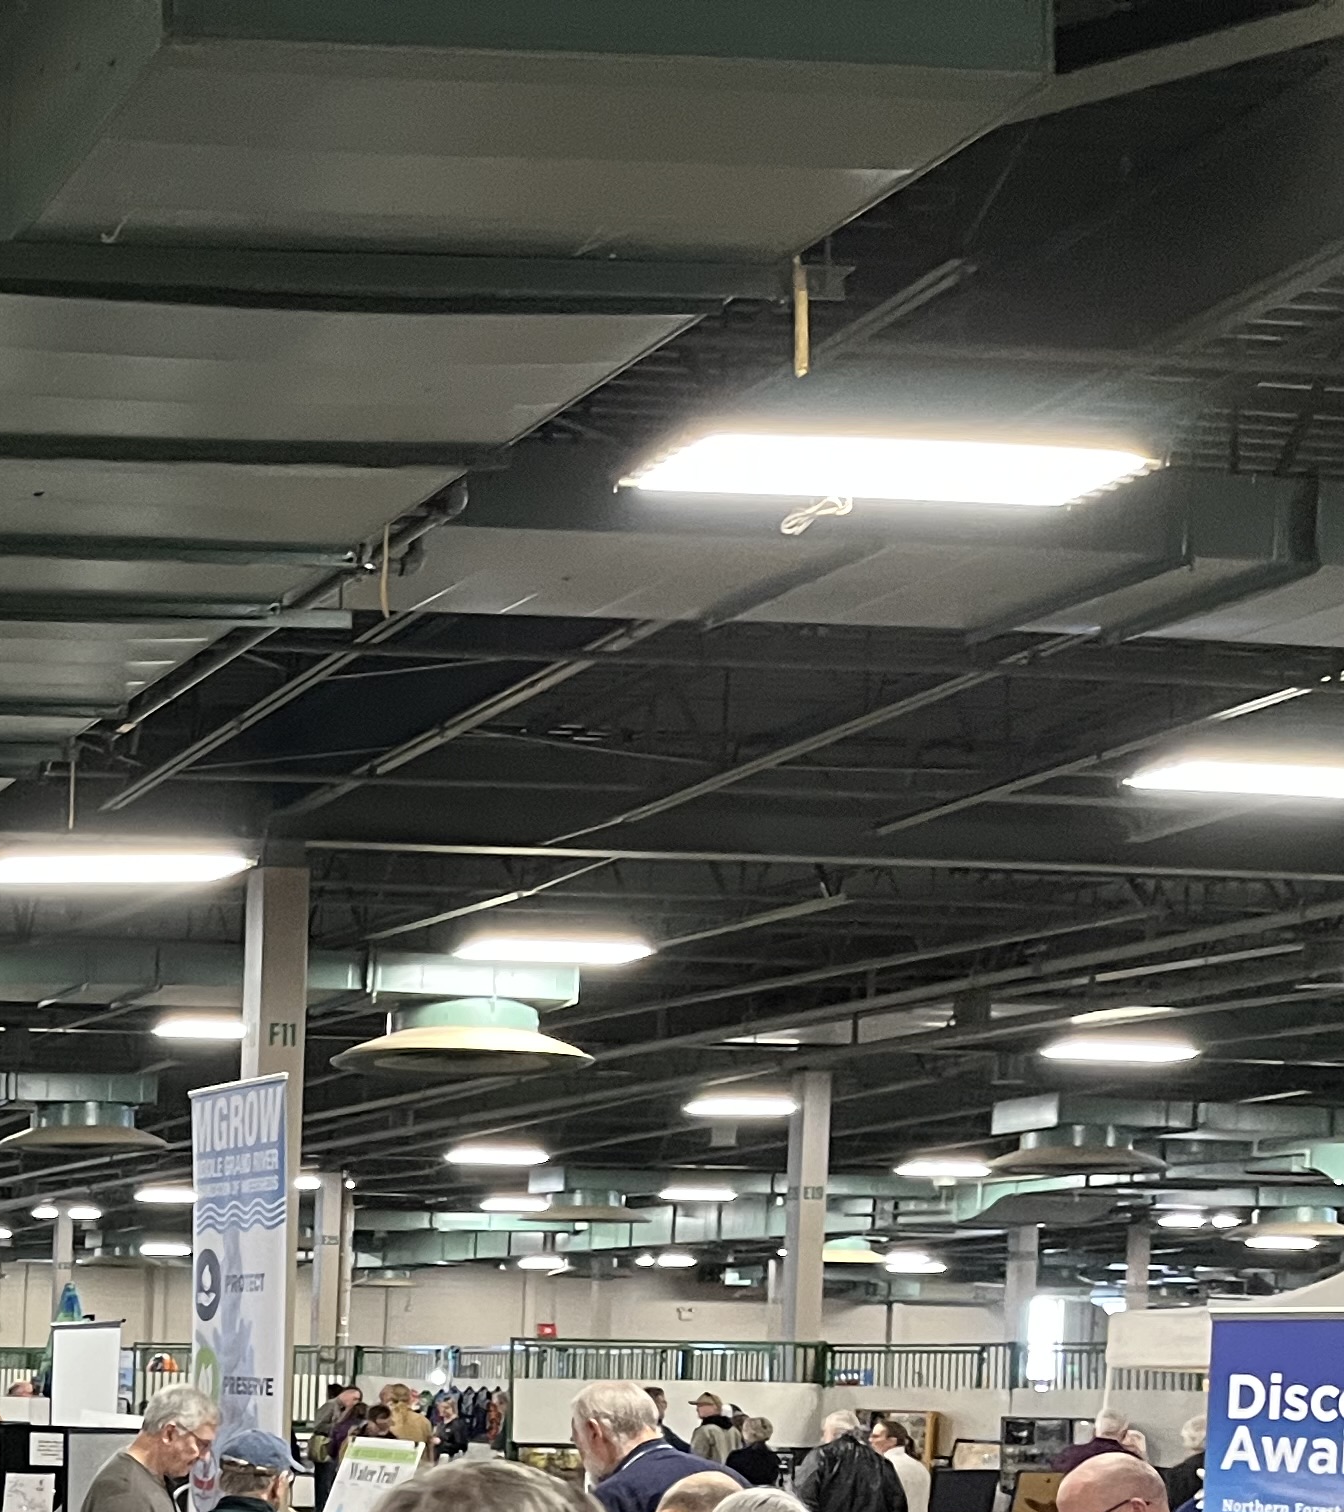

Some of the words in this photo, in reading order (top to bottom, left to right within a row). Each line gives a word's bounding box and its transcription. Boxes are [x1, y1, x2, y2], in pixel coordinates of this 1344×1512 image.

[269, 1022, 296, 1047] F11
[194, 1086, 283, 1152] MGROW
[224, 1273, 266, 1294] PROTECT
[223, 1376, 274, 1396] PRESERVE
[1227, 1372, 1344, 1423] Disc
[1220, 1425, 1344, 1474] Awa
